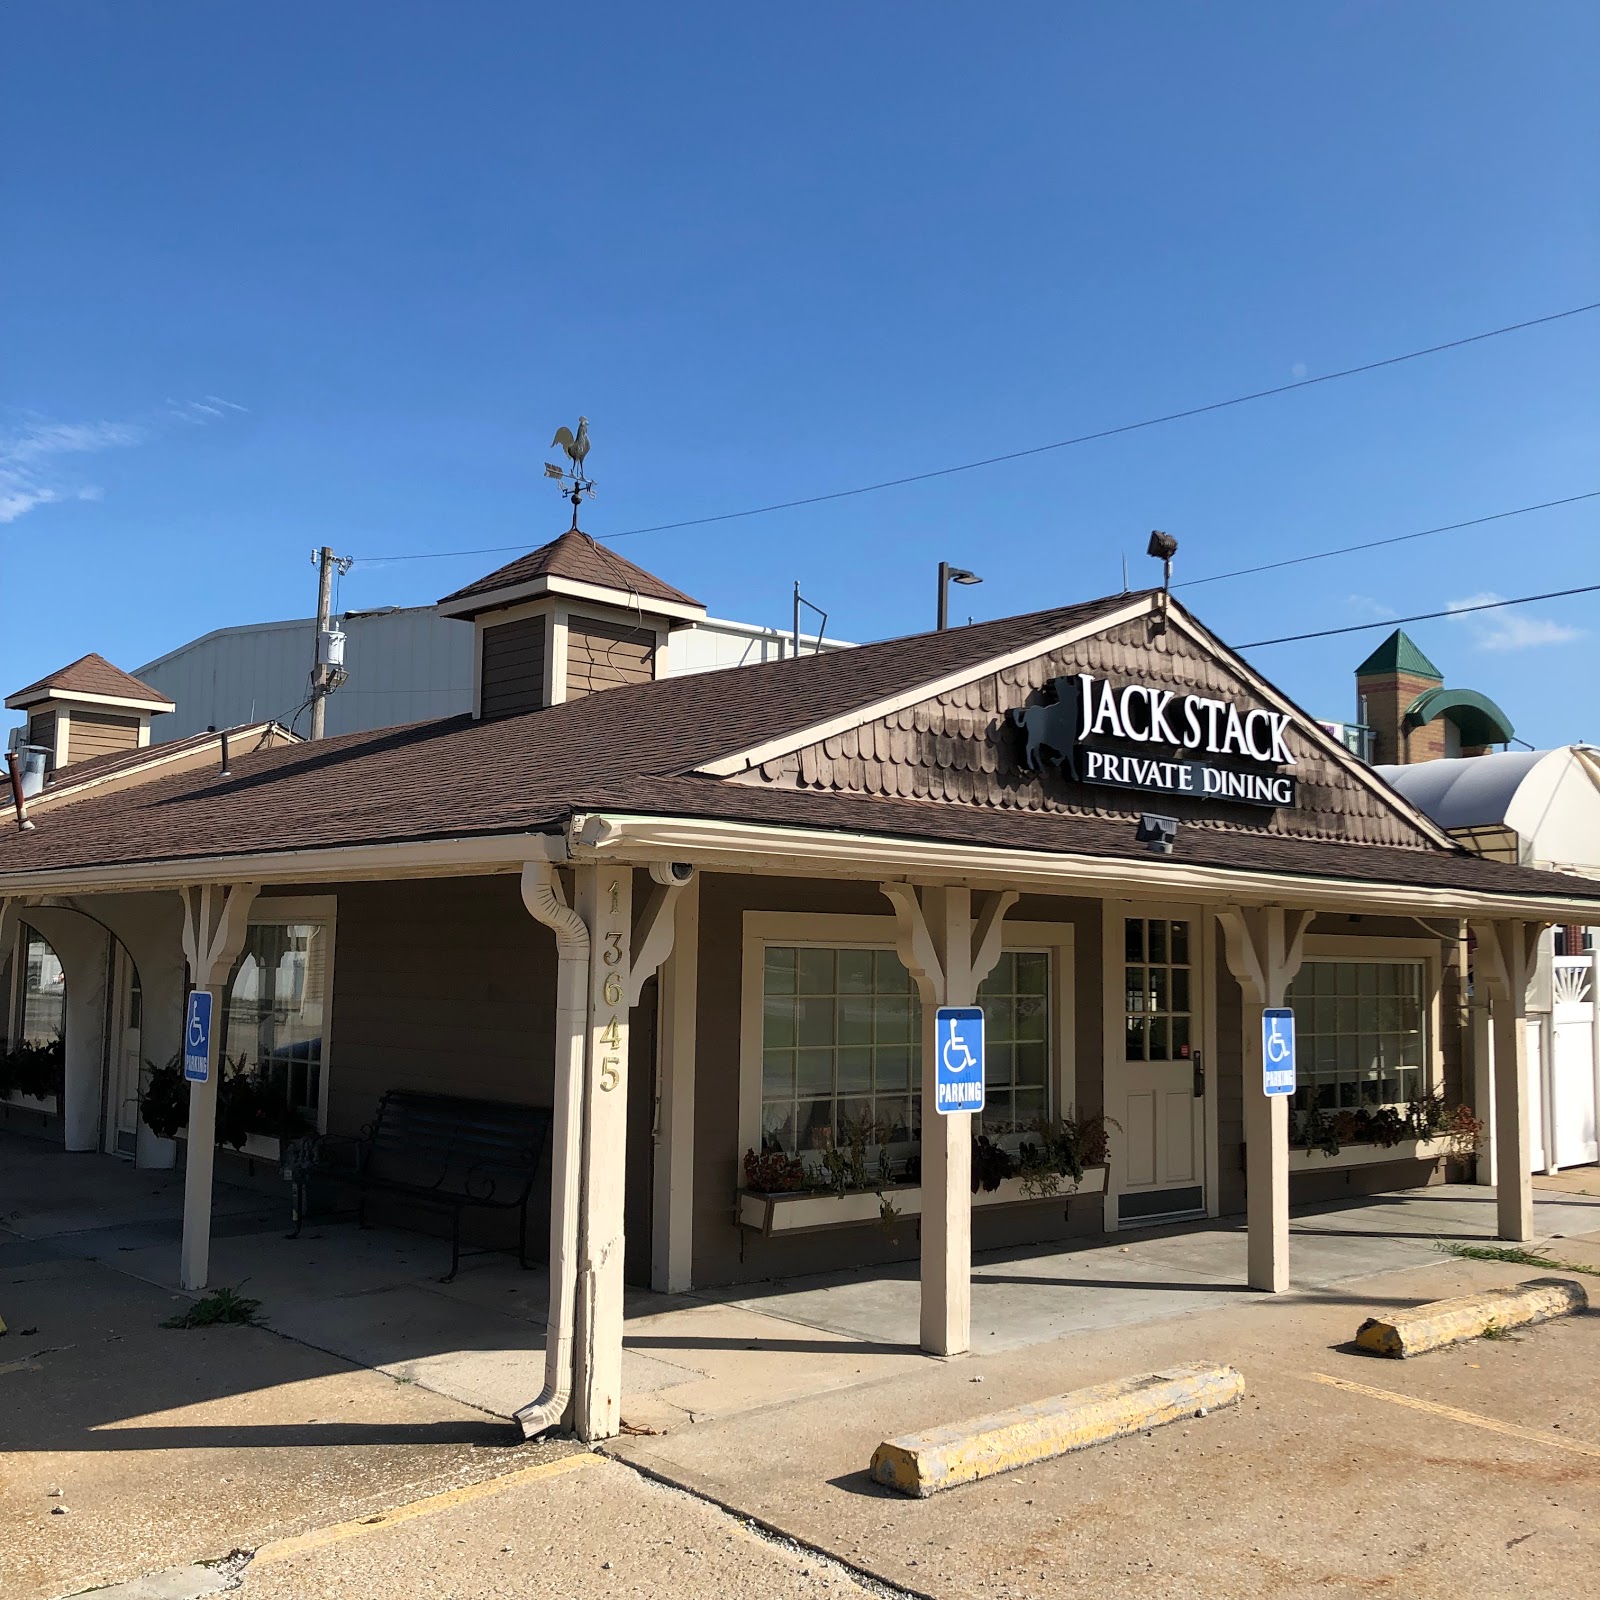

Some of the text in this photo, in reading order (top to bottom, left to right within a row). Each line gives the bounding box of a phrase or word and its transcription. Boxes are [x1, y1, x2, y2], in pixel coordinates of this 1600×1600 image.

[1077, 673, 1298, 765] JACK STACK
[1086, 751, 1292, 804] PRIVATE DINING
[599, 880, 624, 1093] 13645
[186, 1054, 207, 1073] PARKING
[939, 1081, 982, 1103] PARKING
